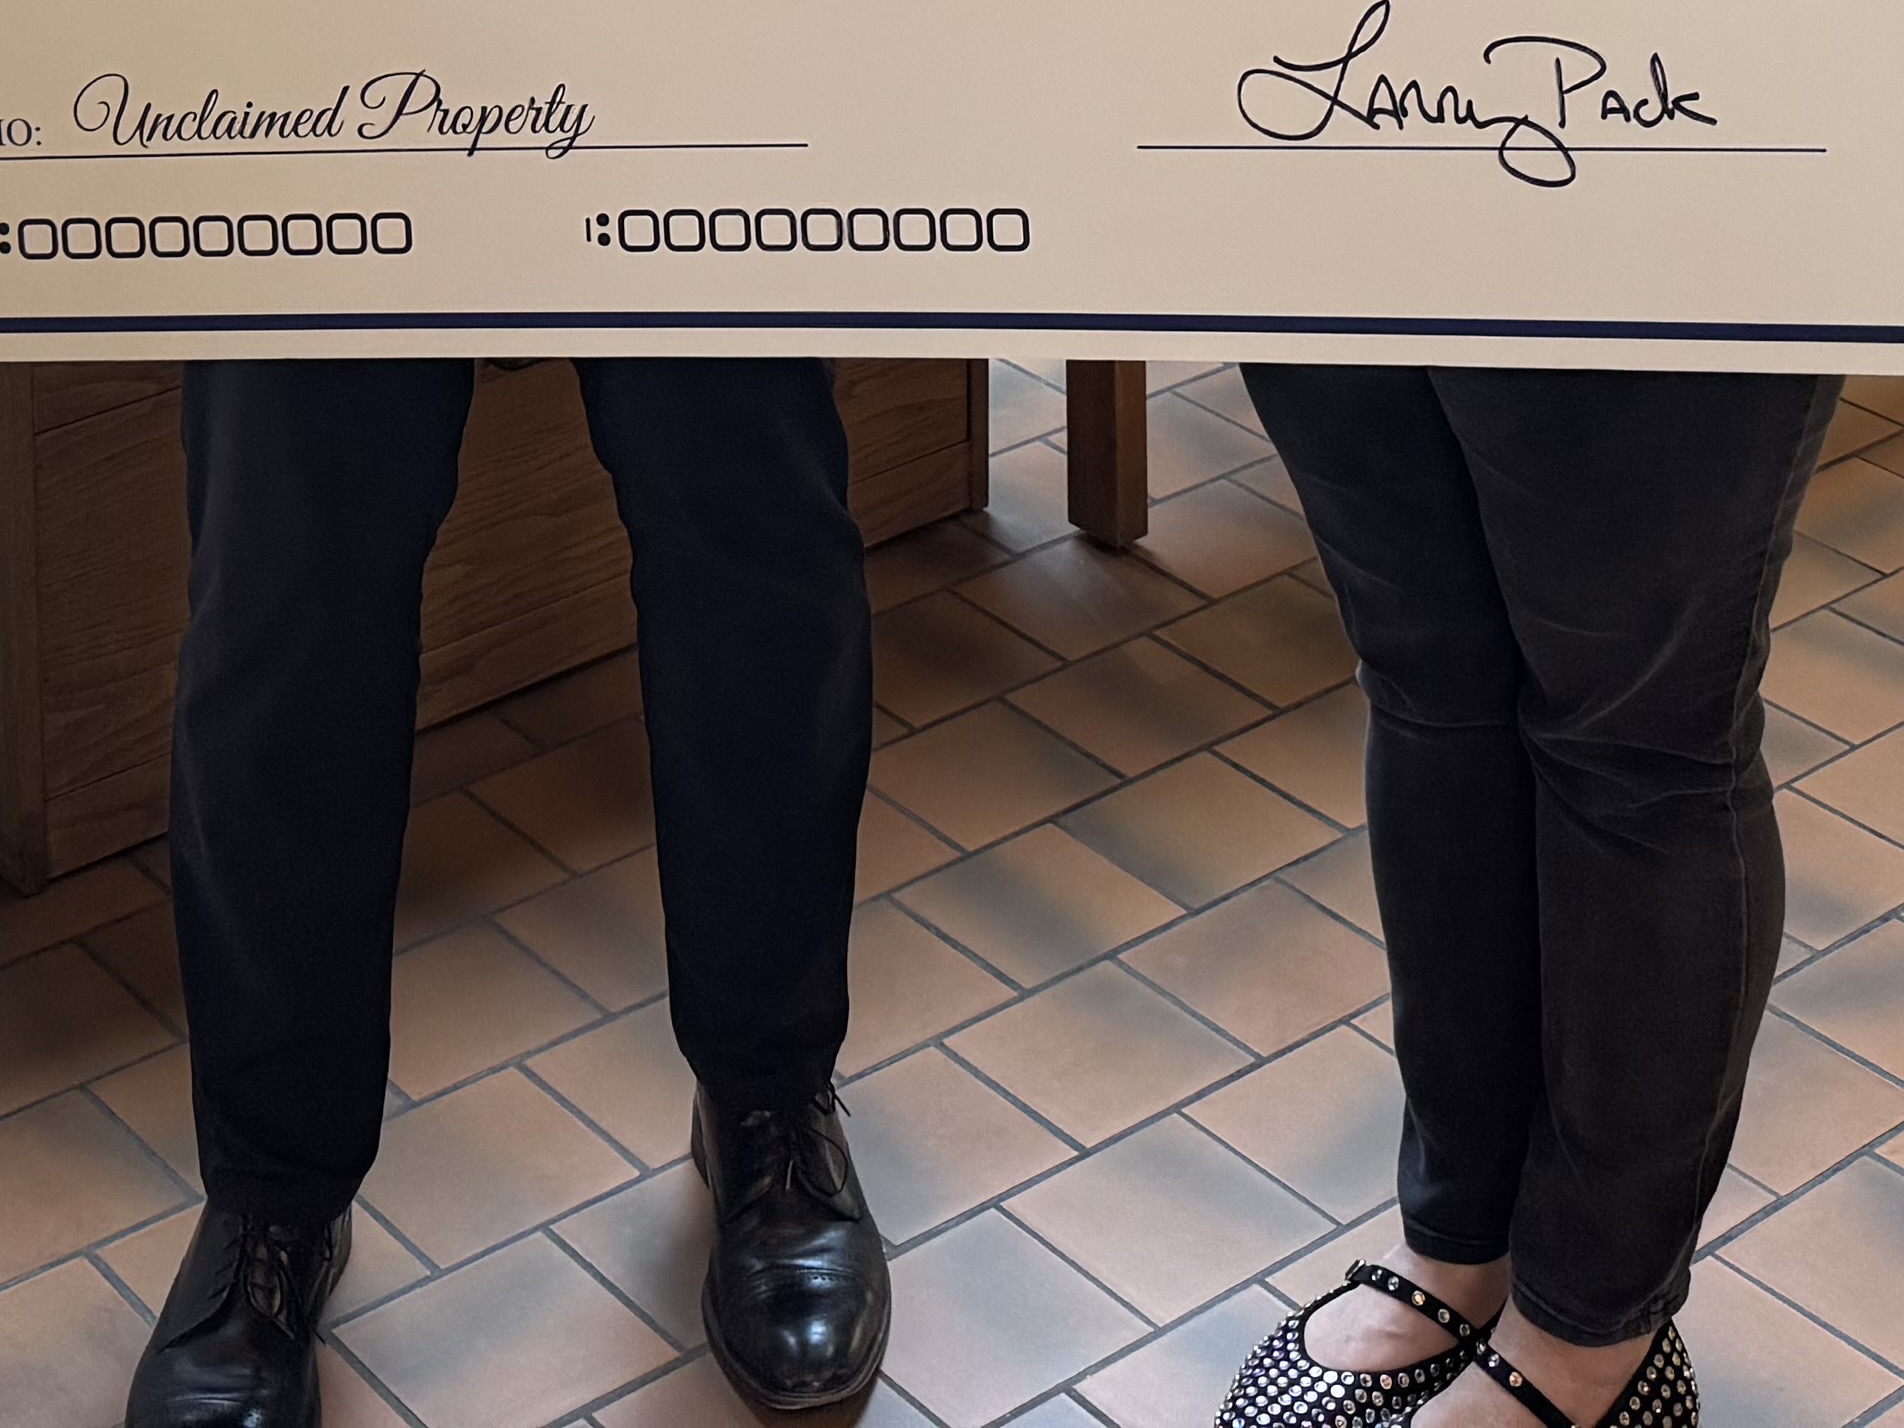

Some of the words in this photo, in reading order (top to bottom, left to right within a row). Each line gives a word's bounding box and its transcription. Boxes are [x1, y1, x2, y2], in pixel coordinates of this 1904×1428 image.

[71, 72, 345, 148] Unclaimed
[356, 67, 596, 160] Property
[1482, 34, 1720, 130] Pack
